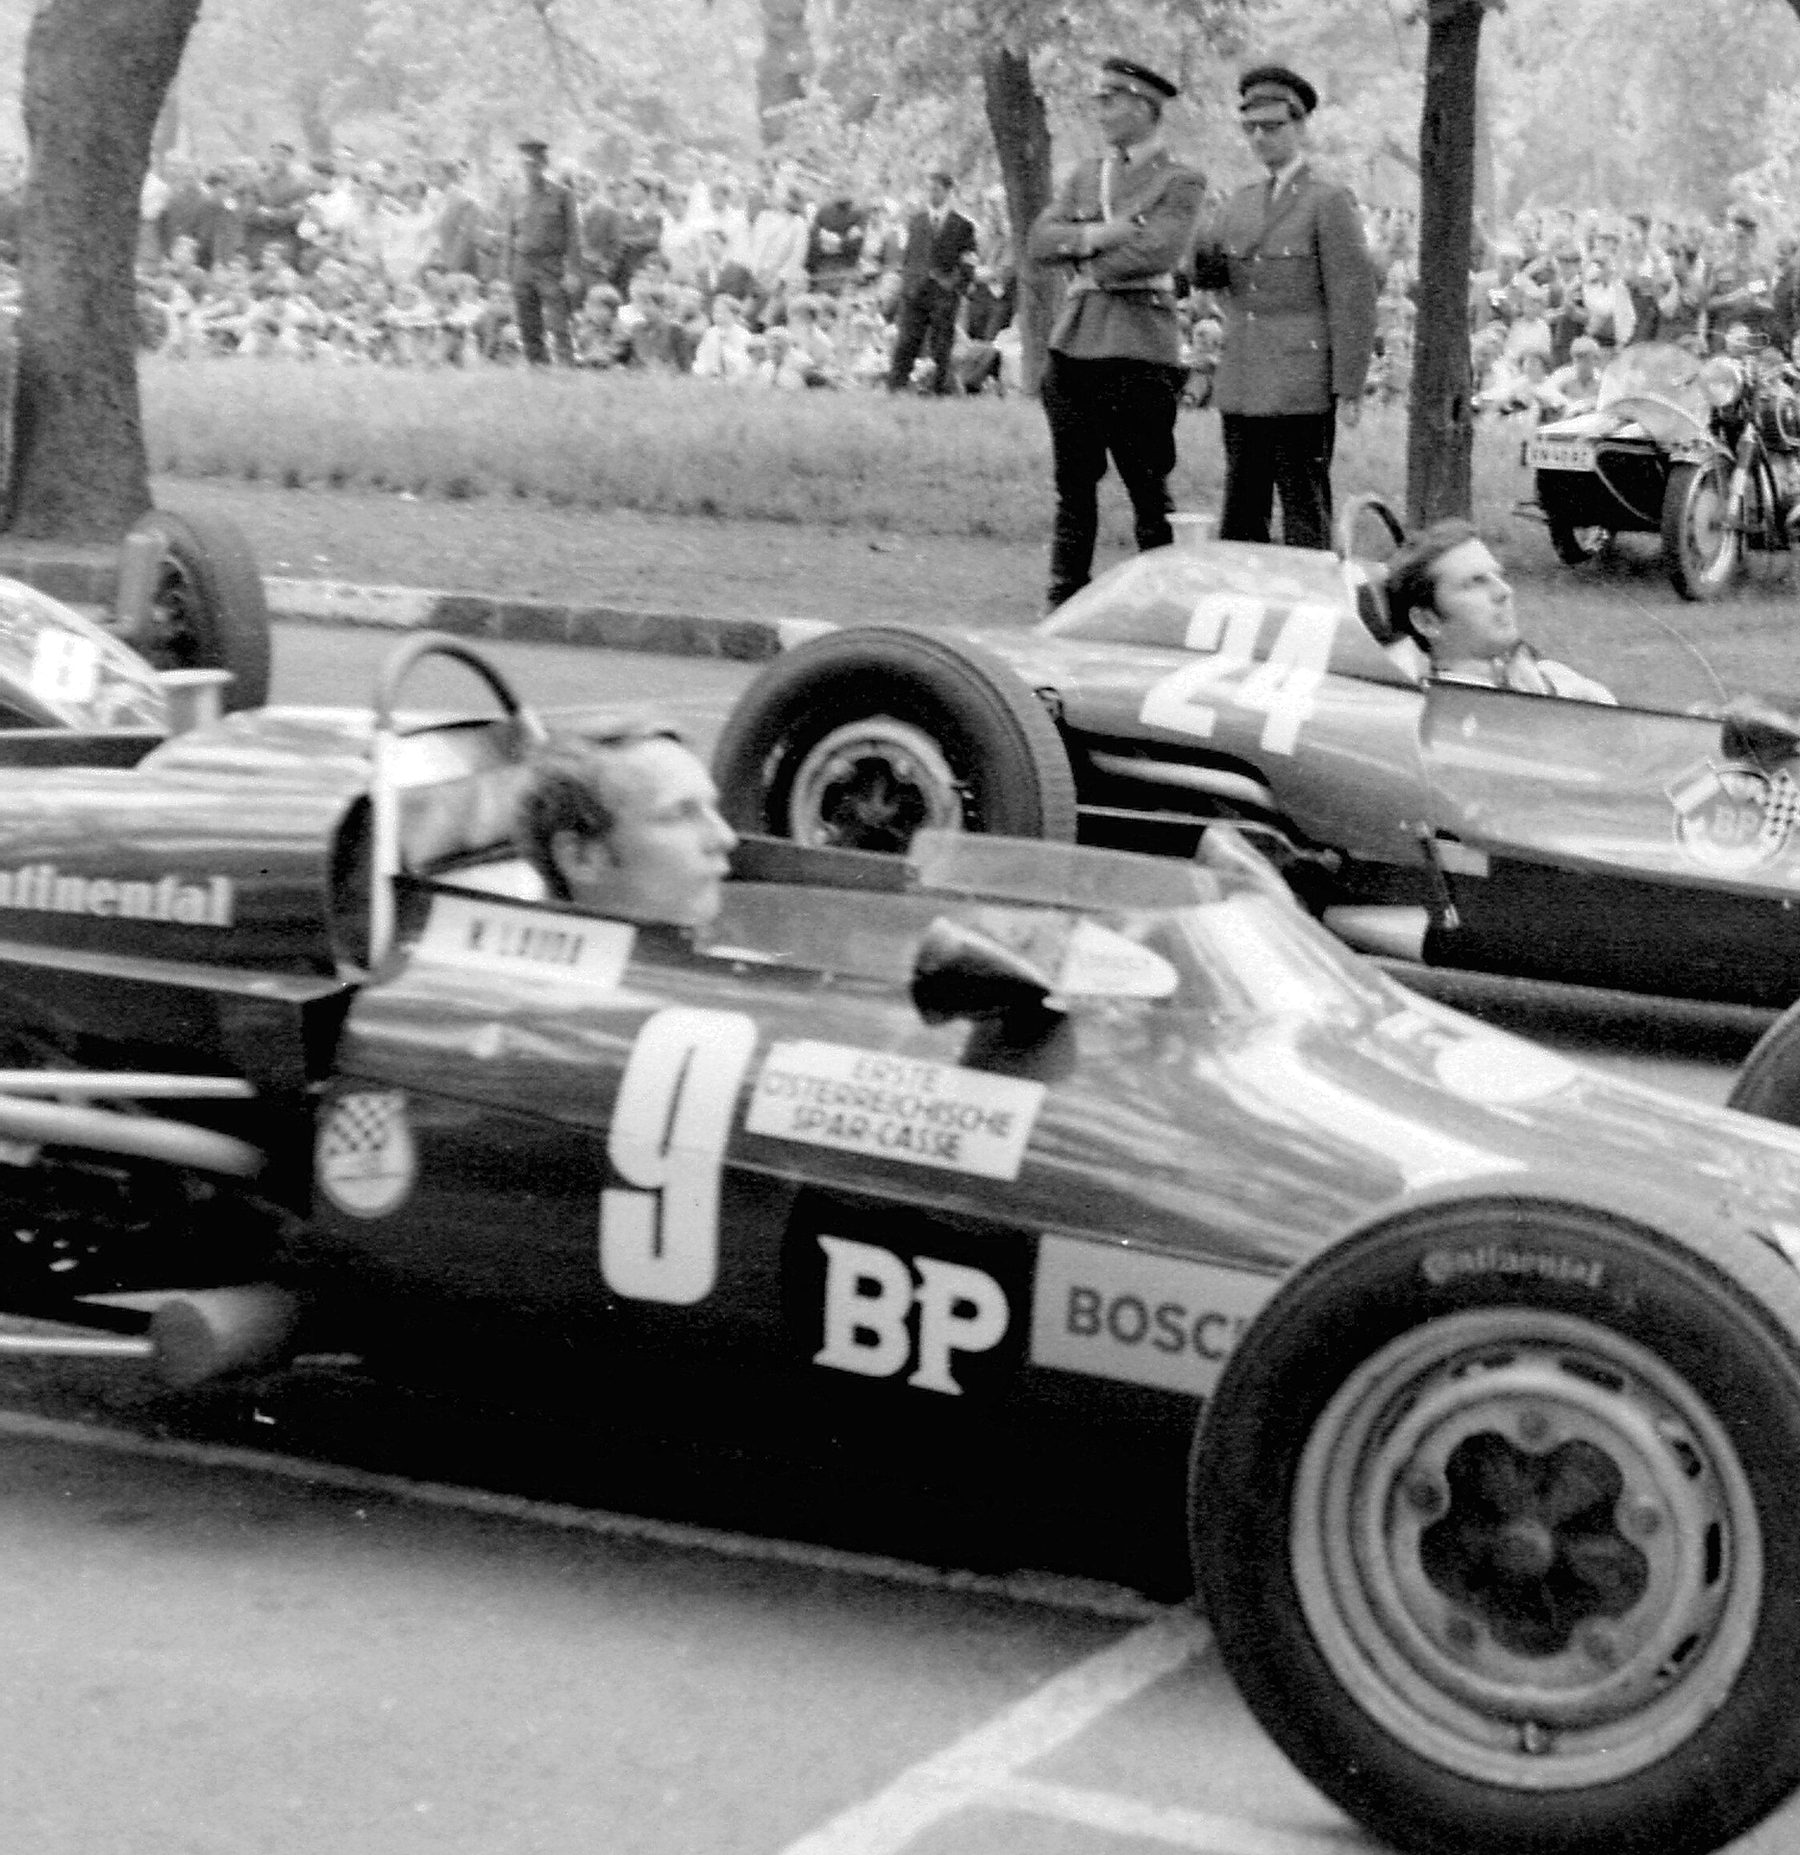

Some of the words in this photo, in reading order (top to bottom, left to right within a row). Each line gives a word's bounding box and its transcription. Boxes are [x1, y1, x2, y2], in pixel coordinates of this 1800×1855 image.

[1139, 593, 1342, 756] 24
[853, 1055, 944, 1093] ERSTE
[600, 1007, 758, 1305] 9
[812, 1234, 1010, 1396] BP
